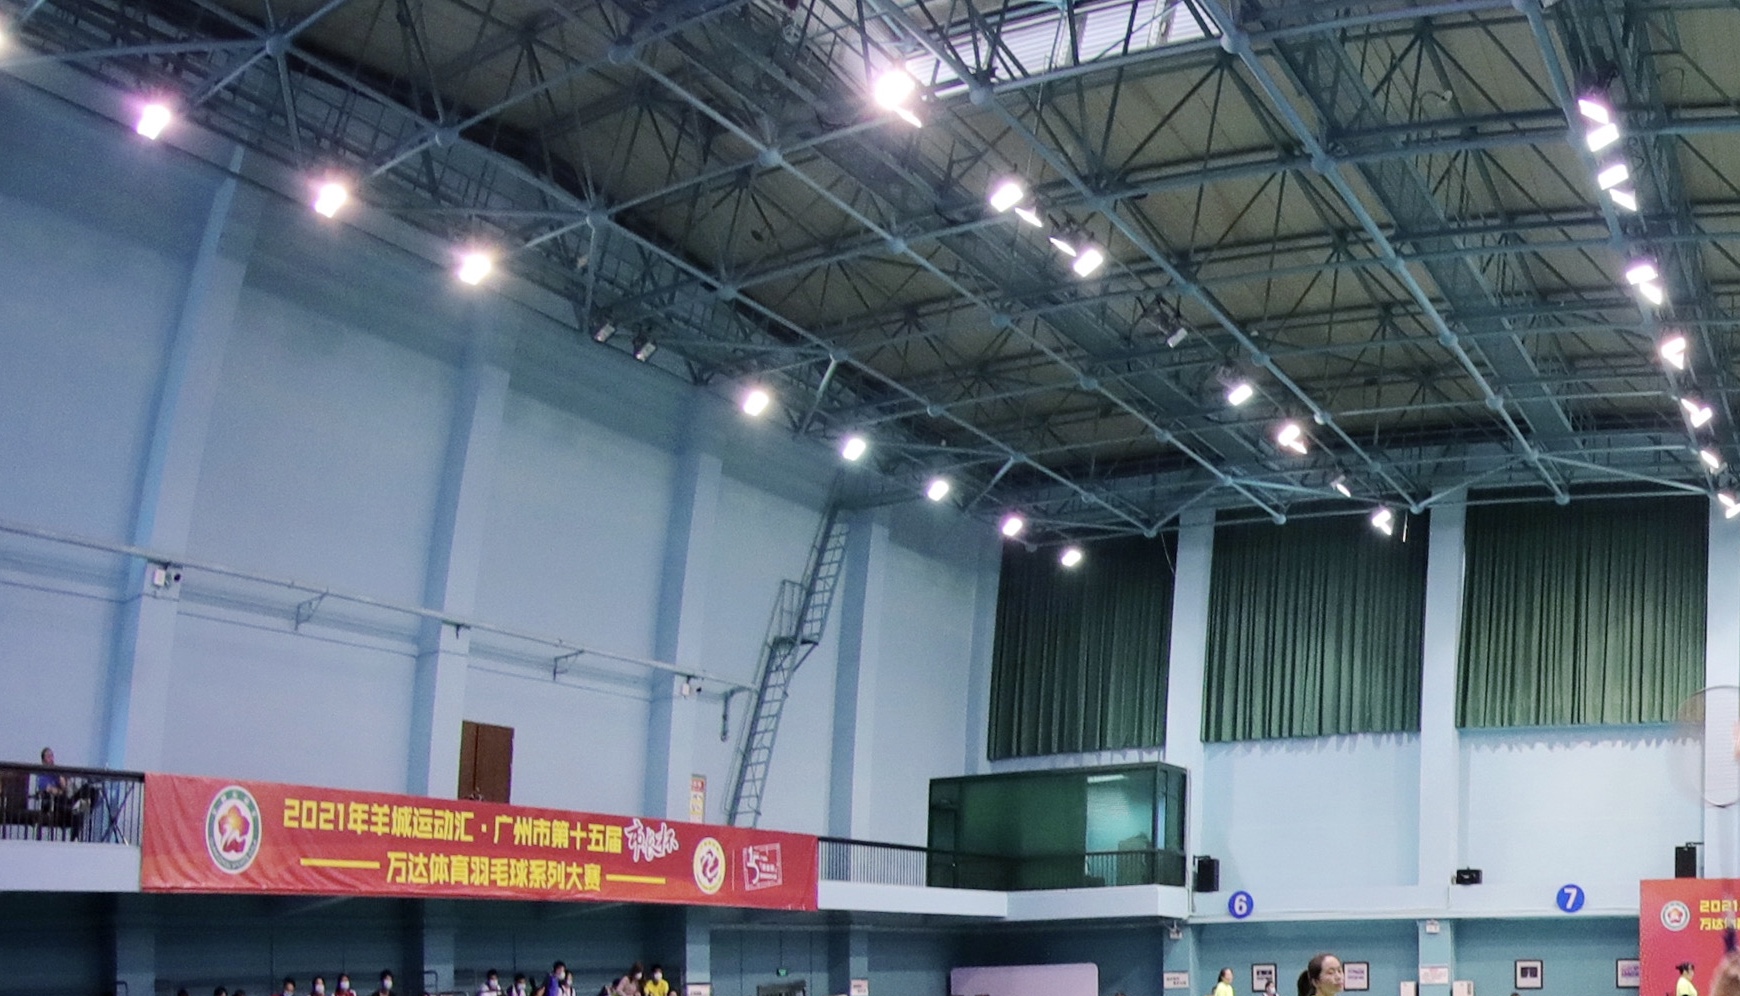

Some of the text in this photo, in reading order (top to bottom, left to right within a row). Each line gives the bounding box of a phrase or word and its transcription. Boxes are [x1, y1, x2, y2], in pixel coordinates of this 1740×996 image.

[386, 851, 601, 892] 万达体育羽毛球系列大赛
[1234, 894, 1247, 915] 6
[1563, 888, 1578, 910] 7
